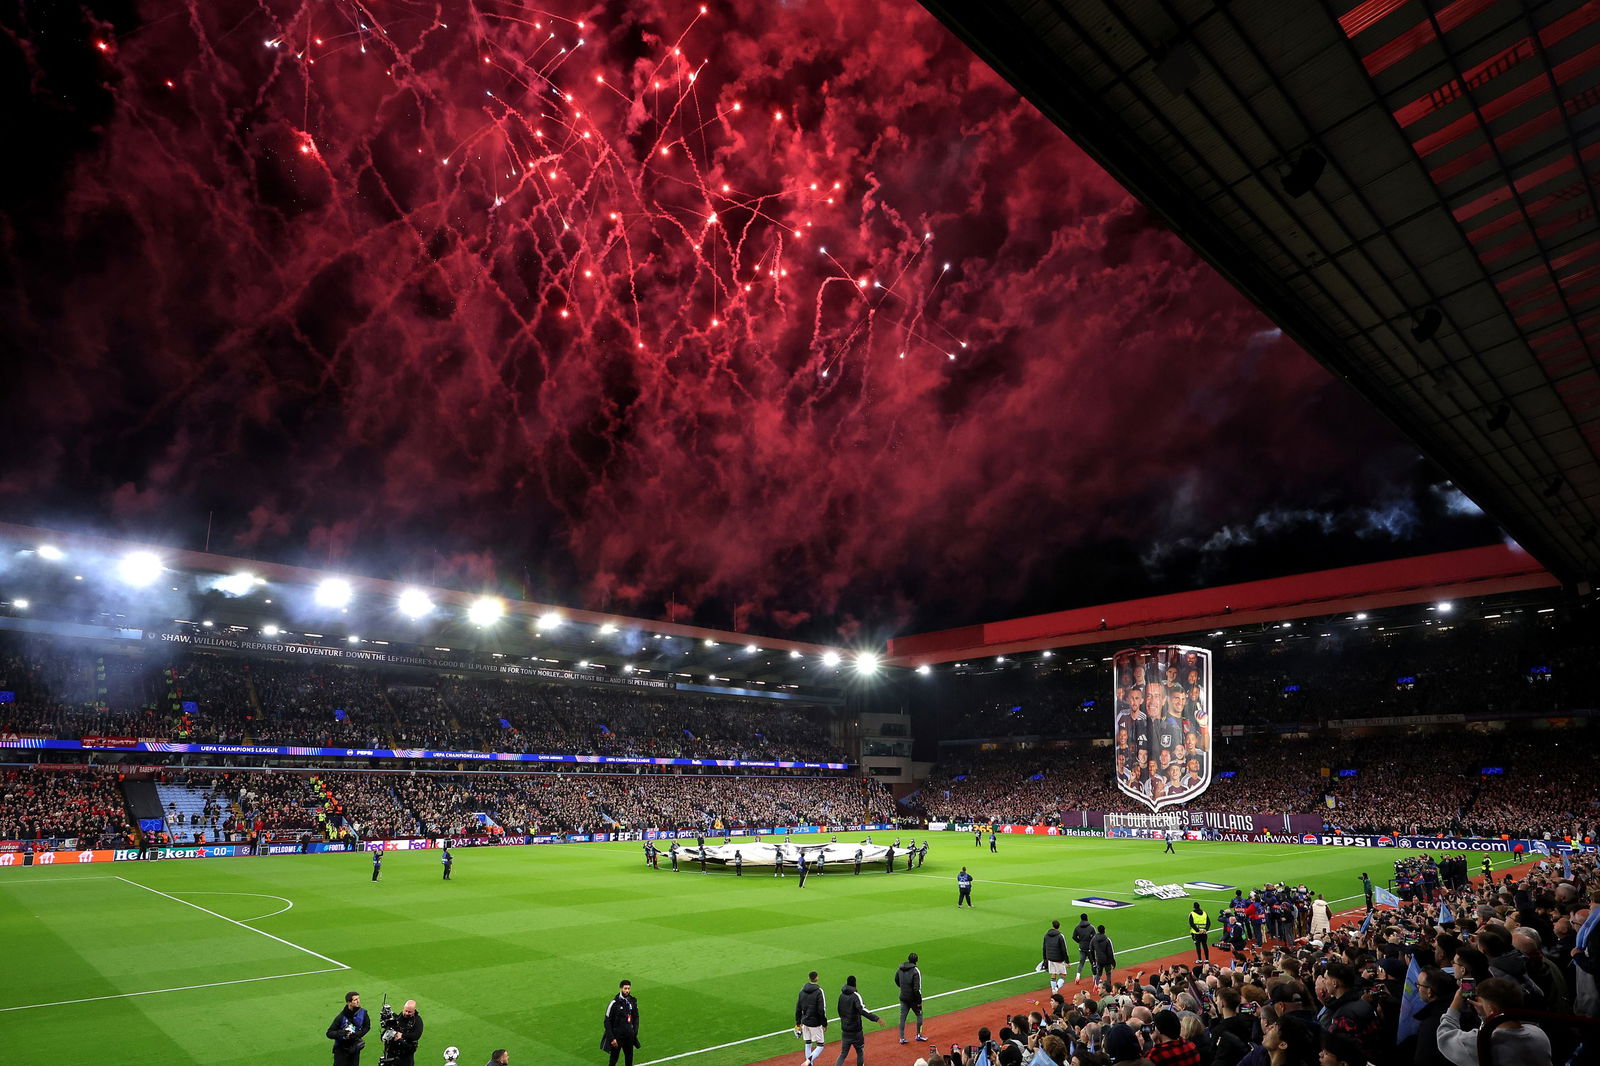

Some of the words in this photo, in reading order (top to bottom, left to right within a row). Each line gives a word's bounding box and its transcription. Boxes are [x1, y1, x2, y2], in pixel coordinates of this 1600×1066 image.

[161, 633, 192, 643] SHAW,
[194, 636, 240, 648] WILLIAMS,
[241, 641, 283, 652] PREPARED
[285, 645, 295, 653] TO
[296, 646, 343, 657] ADVENTURE
[345, 651, 370, 660] DOWN
[372, 653, 386, 661] THE
[475, 663, 498, 671] PLAYED
[1109, 812, 1124, 827] ALL
[1127, 812, 1147, 827] OUR
[1151, 810, 1189, 828] HEROES
[1191, 813, 1204, 825] ARE
[1205, 811, 1254, 831] VILLANS
[954, 823, 993, 833] bet365
[1253, 834, 1299, 844] AIRWAYS
[1321, 836, 1372, 847] PEPSI
[269, 846, 297, 854] WELCOME
[365, 840, 399, 851] FedEx
[1416, 839, 1507, 852] crypto.com
